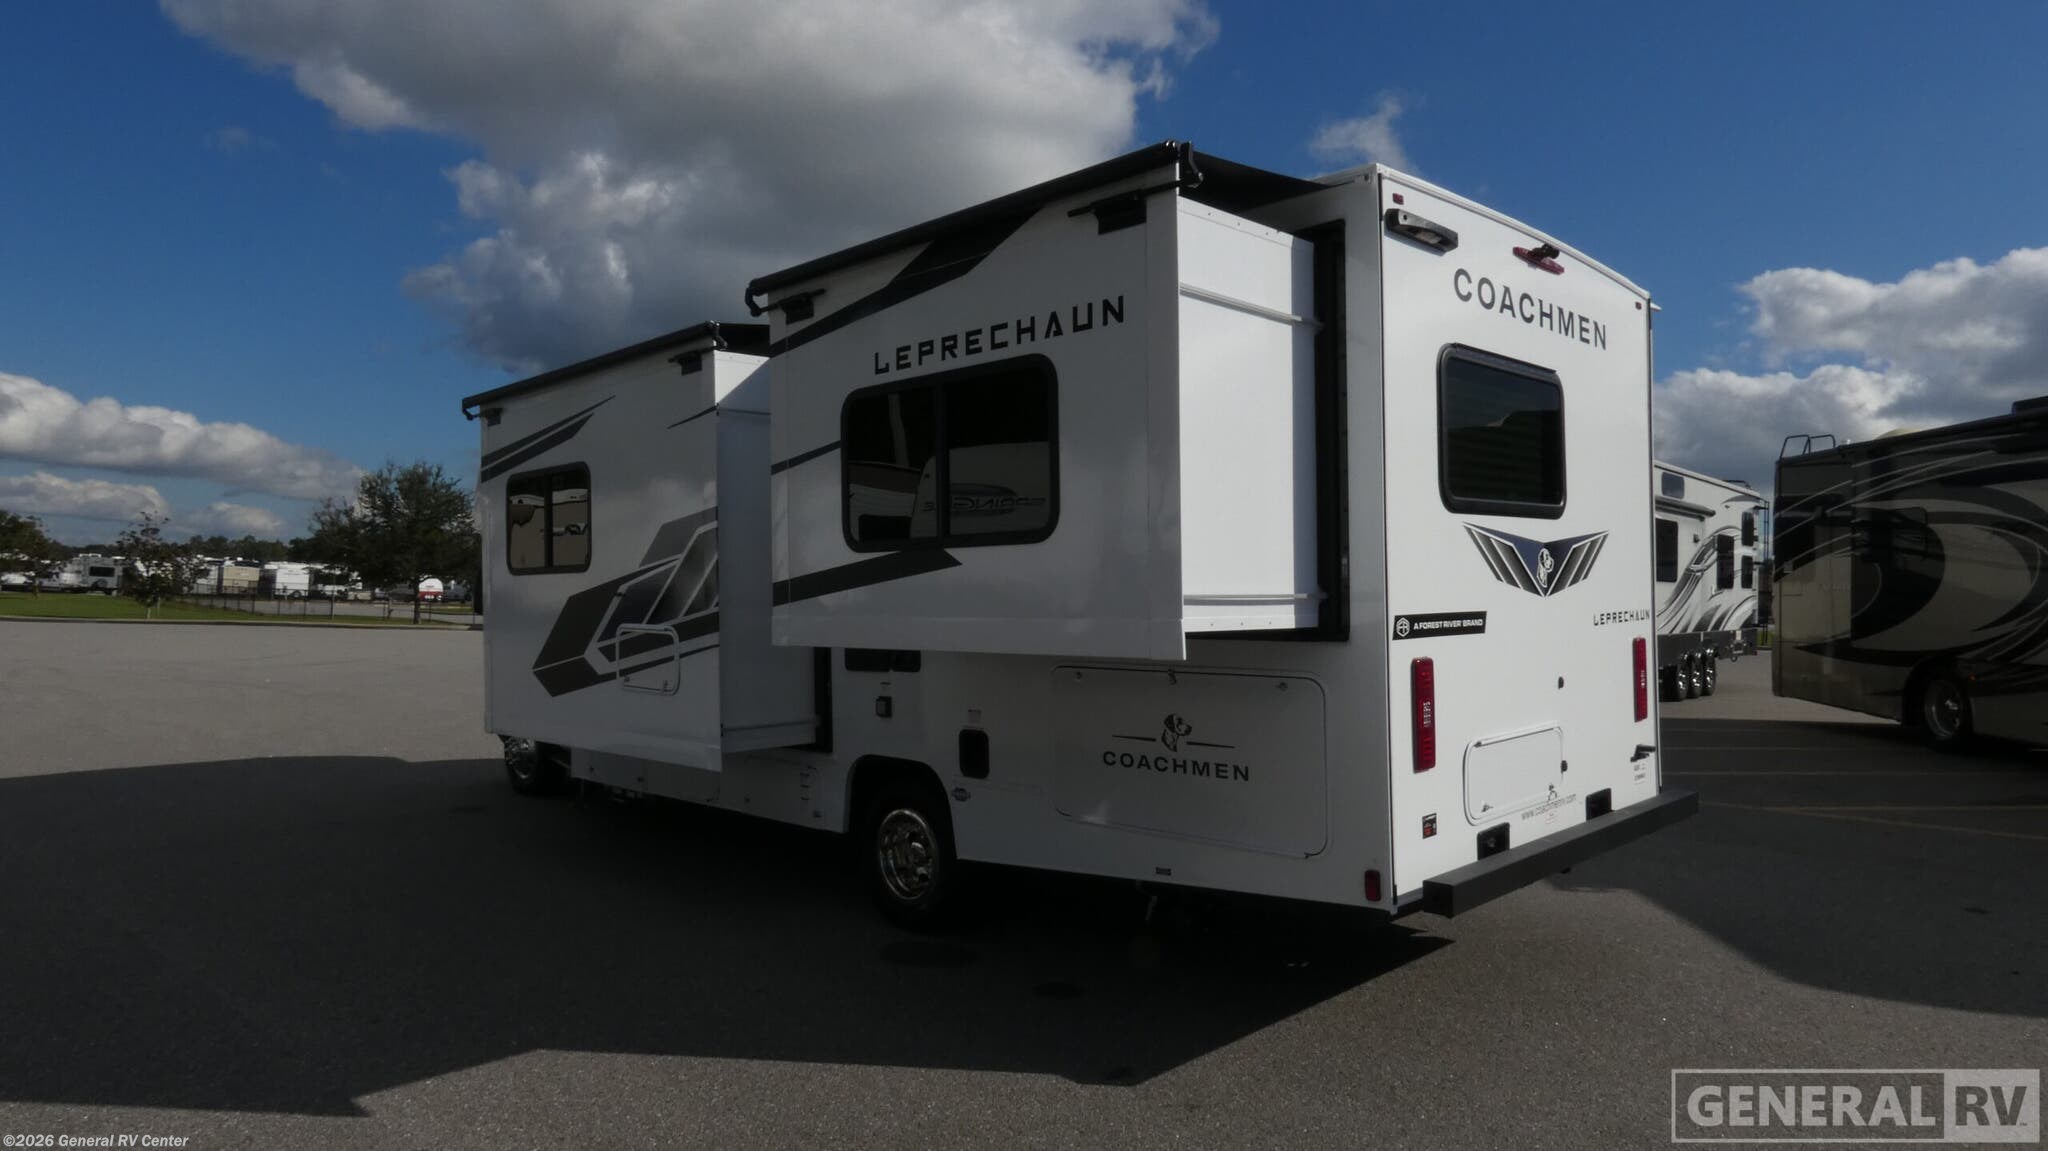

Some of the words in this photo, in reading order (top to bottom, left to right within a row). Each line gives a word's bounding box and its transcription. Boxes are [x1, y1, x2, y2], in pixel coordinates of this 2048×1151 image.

[1453, 268, 1607, 350] COACHMEN
[874, 295, 1125, 375] LEPRECHAUN
[1419, 621, 1443, 631] FOREST
[1444, 620, 1462, 629] RIVER
[1463, 618, 1484, 628] BRAND
[1593, 609, 1651, 627] LEPRECHAUN
[1102, 751, 1249, 782] COACHMEN
